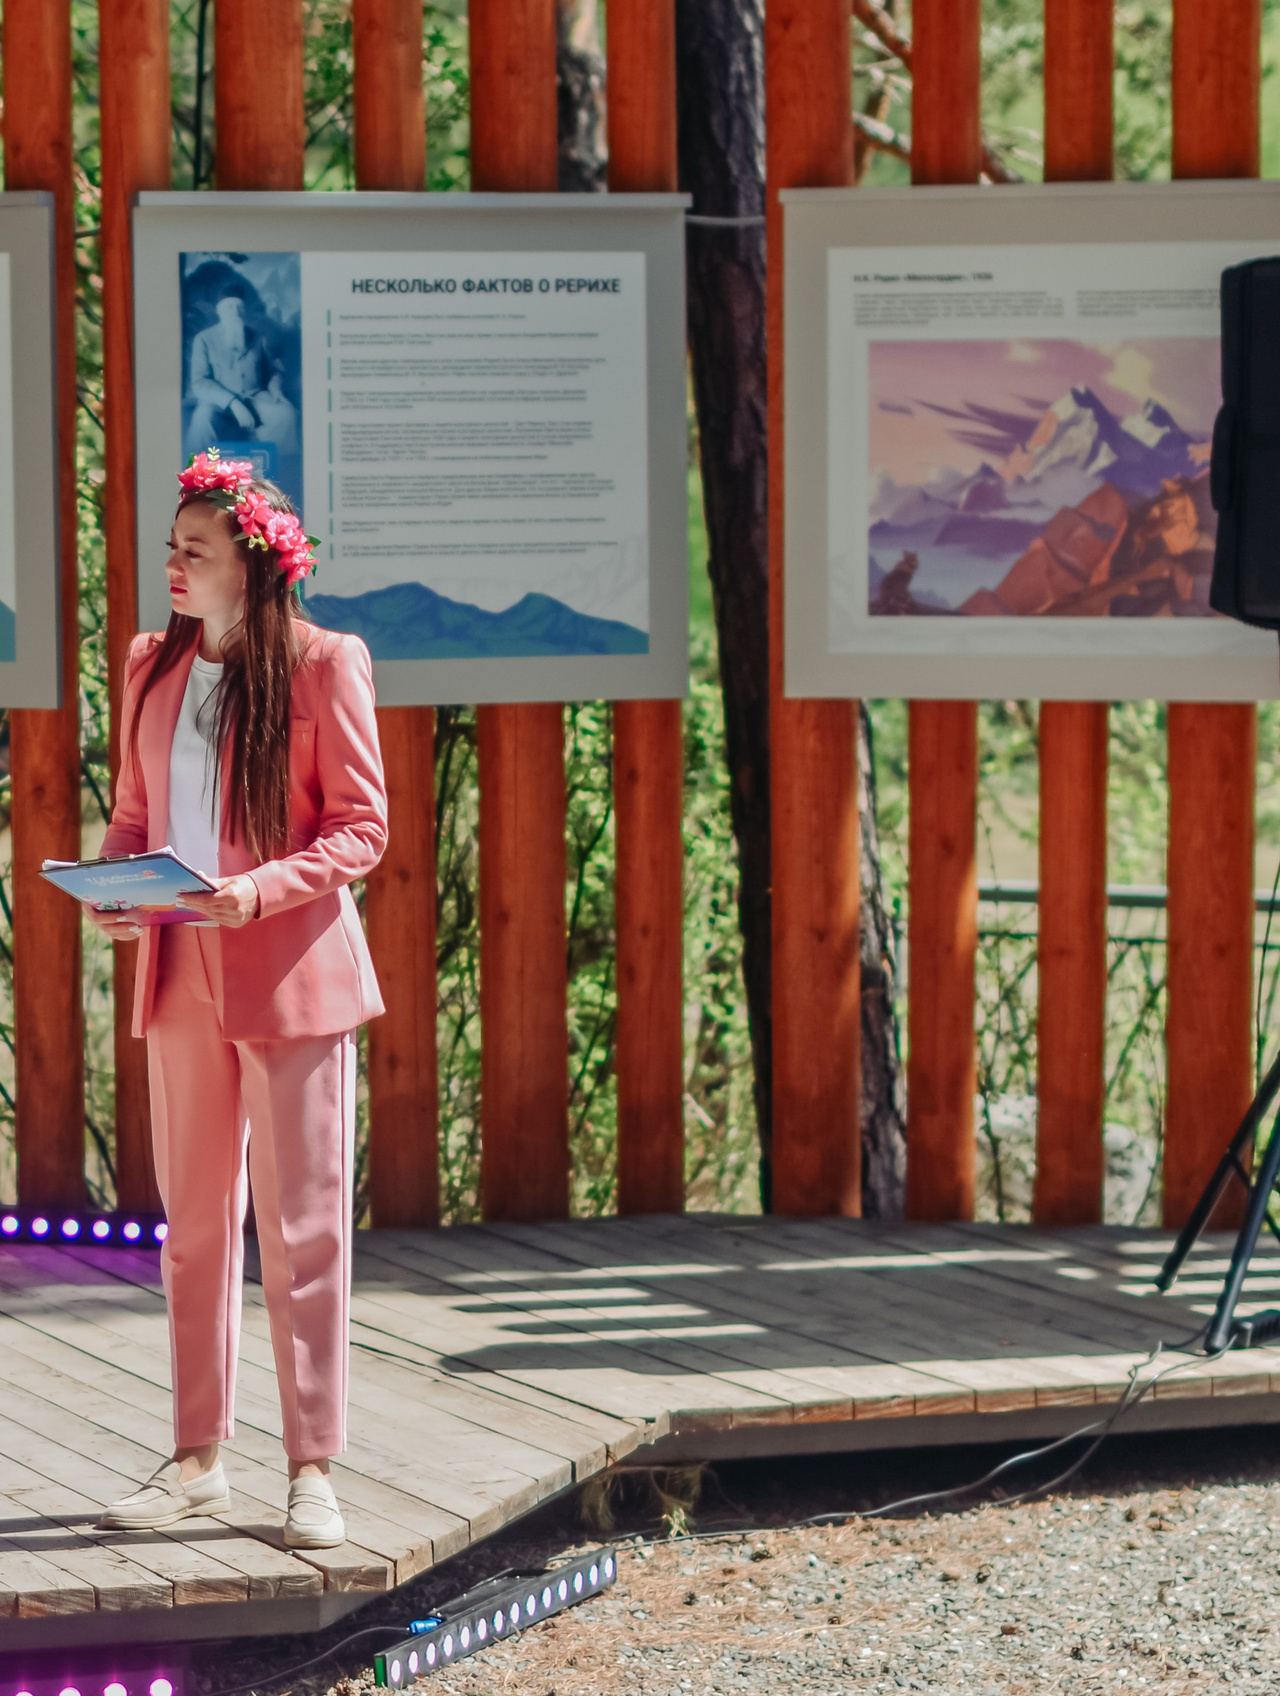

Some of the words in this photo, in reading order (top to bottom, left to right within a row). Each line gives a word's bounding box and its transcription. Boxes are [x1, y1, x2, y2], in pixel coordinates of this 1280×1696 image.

[351, 278, 457, 294] НЕСКОЛЬКО
[461, 278, 534, 294] ФАКТОВ
[538, 278, 550, 294] О
[554, 277, 620, 294] РЕРИХЕ
